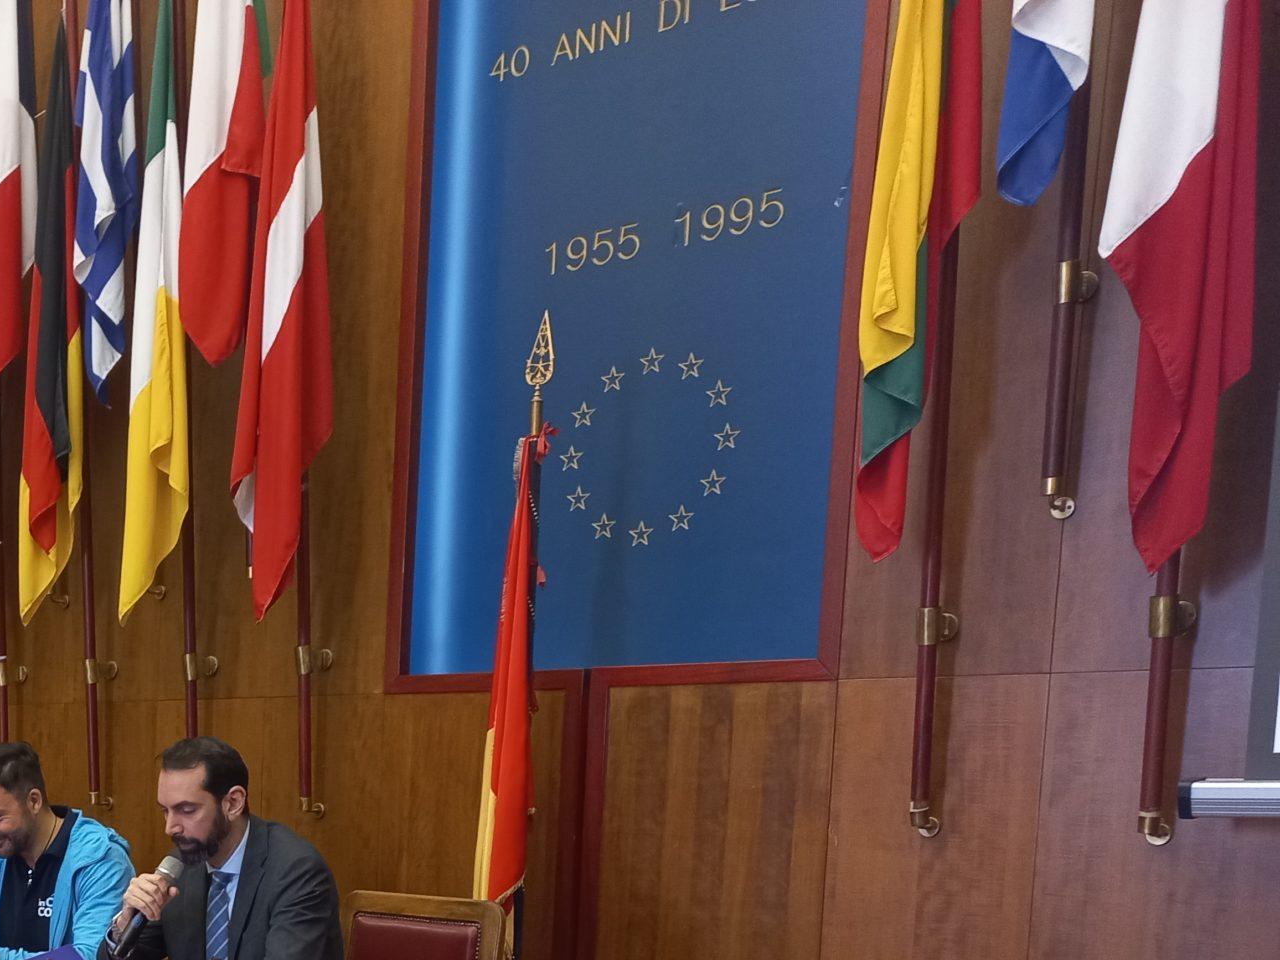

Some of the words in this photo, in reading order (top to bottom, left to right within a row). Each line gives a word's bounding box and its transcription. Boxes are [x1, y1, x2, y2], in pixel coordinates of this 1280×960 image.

[489, 45, 530, 82] 40
[551, 11, 632, 66] ANNI
[658, 0, 690, 32] DI
[545, 222, 640, 276] 1955
[675, 188, 786, 247] 1995
[38, 906, 53, 917] CO
